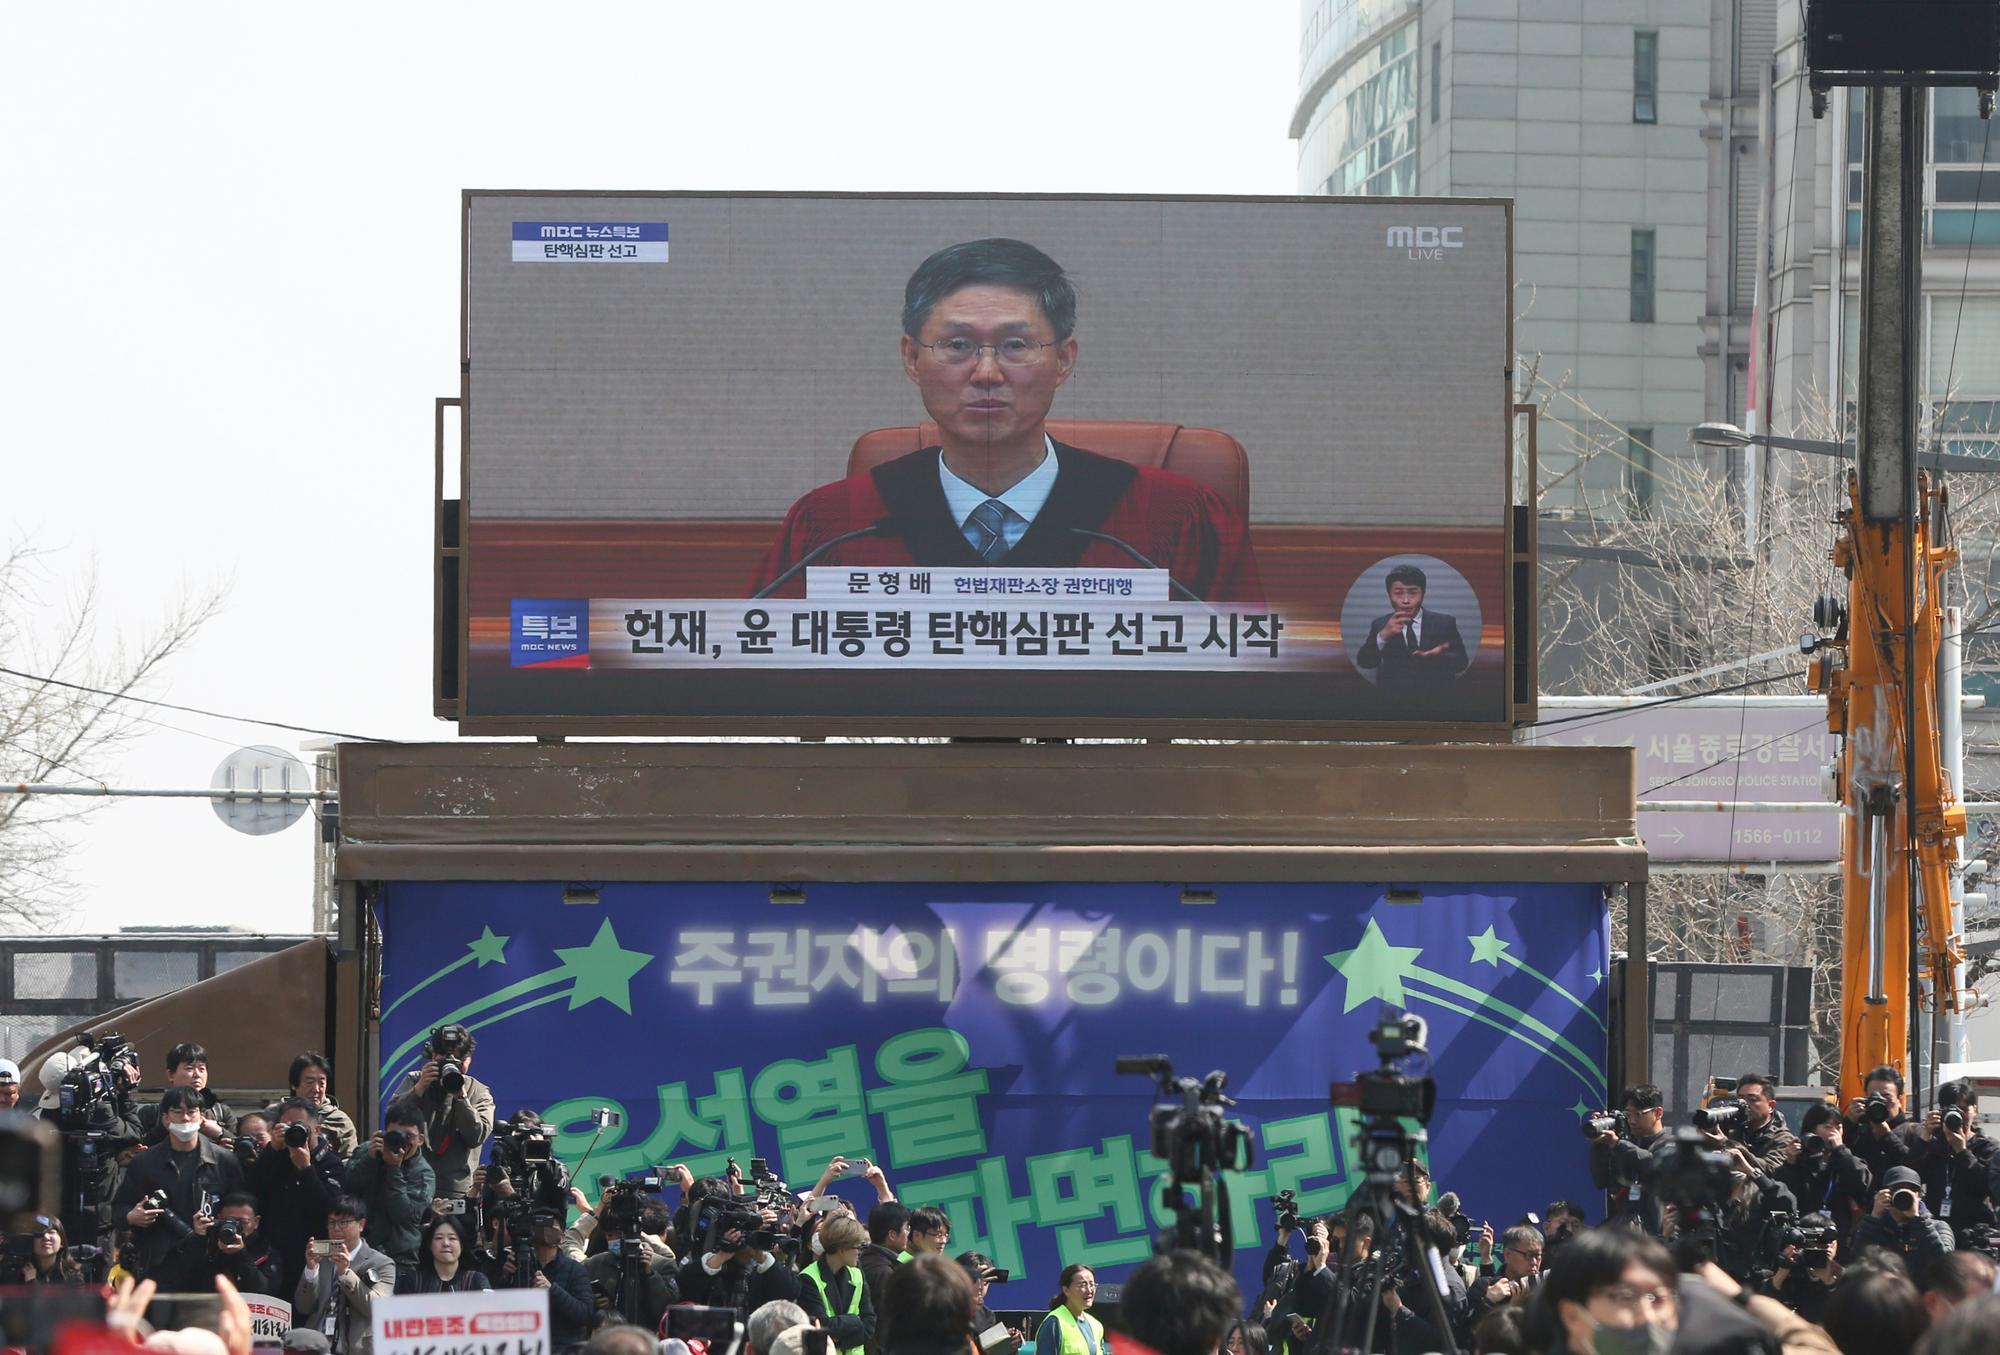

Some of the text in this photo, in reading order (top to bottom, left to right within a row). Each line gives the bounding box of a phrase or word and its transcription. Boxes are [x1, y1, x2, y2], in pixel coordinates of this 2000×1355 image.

[540, 226, 641, 239] MBC 뉴스특보
[1386, 226, 1464, 248] MBC
[544, 243, 638, 259] 탄핵심판 선고
[1408, 248, 1444, 261] LIVE
[953, 576, 1060, 596] 헌법재판소장
[1063, 577, 1133, 596] 권한대행
[521, 614, 578, 640] 특보
[624, 608, 1284, 659] 헌재, 윤 대통령 탄핵심판 선고 시작
[520, 643, 577, 651] MBC NEWS
[1645, 732, 1826, 765] 서울종로경찰서
[1649, 775, 1822, 788] SEOUL JONGNO POLICE STATIO
[1734, 828, 1822, 845] 1566-0112
[670, 926, 1300, 1007] 주권자의 명령이다!
